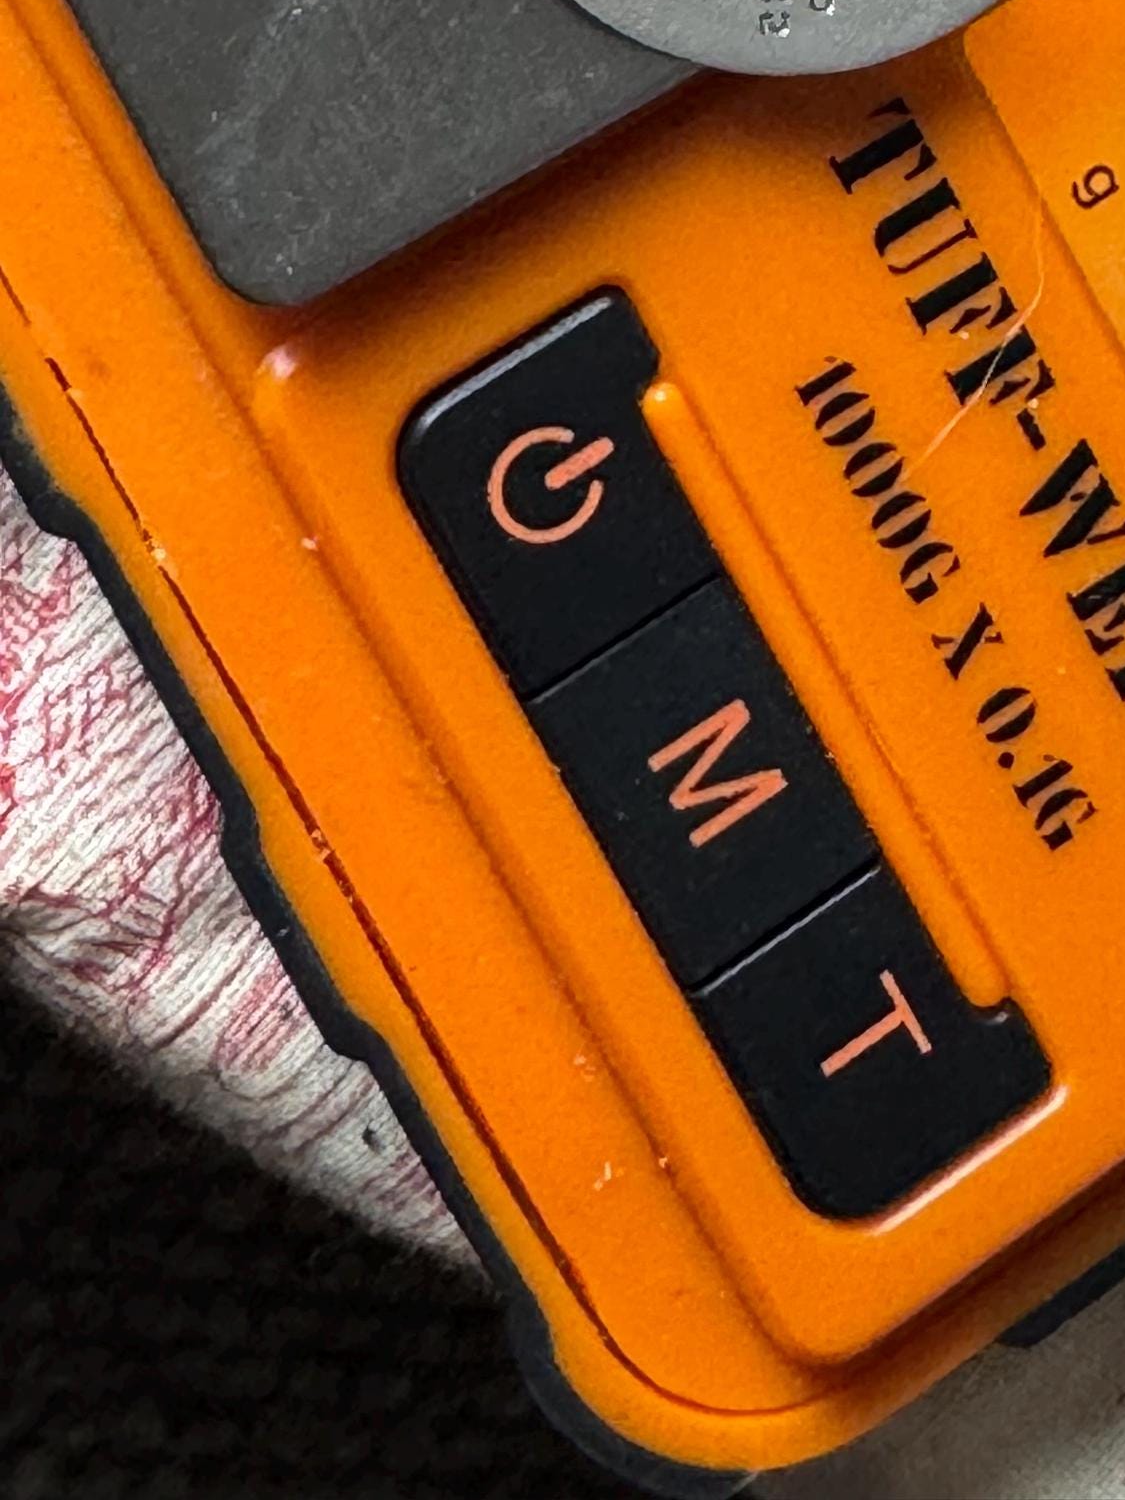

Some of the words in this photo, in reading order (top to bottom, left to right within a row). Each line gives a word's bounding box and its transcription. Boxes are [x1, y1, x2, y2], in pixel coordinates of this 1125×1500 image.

[1071, 164, 1120, 211] g
[794, 355, 961, 605] 1000G
[976, 686, 1097, 852] 0.1G
[647, 698, 789, 848] M
[819, 969, 933, 1077] T
